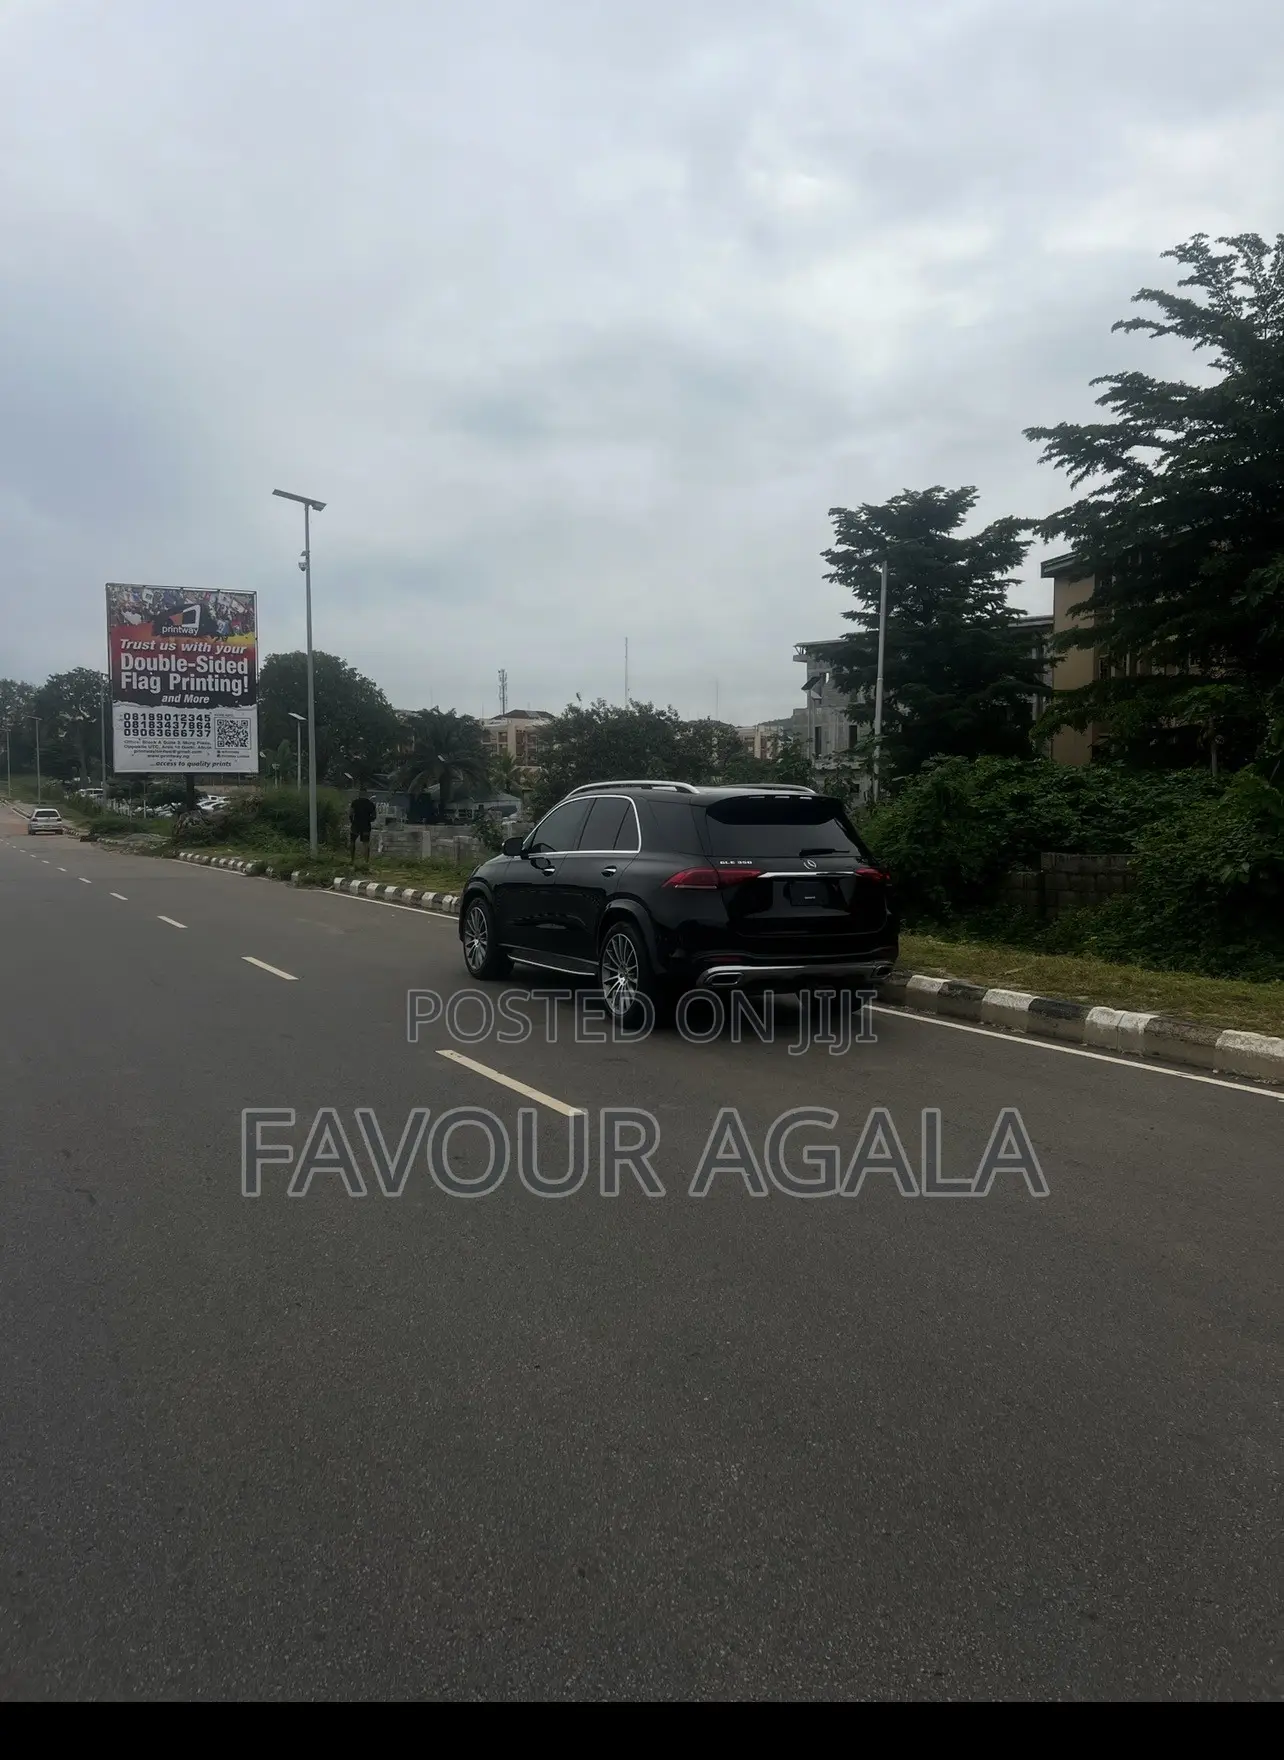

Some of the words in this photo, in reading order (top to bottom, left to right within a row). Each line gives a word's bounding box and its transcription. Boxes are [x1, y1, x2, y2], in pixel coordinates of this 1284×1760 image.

[162, 625, 199, 636] printway
[120, 639, 156, 651] Trust
[160, 641, 176, 651] us
[181, 642, 211, 653] with
[215, 643, 247, 655] your
[120, 652, 248, 674] Double-Sided
[121, 672, 161, 694] Flag
[169, 673, 249, 697] Printing!
[161, 694, 181, 703] and
[183, 694, 210, 704] More
[123, 712, 211, 722] 08189012345
[123, 720, 211, 730] 08183437864
[123, 728, 211, 738] 09063666737
